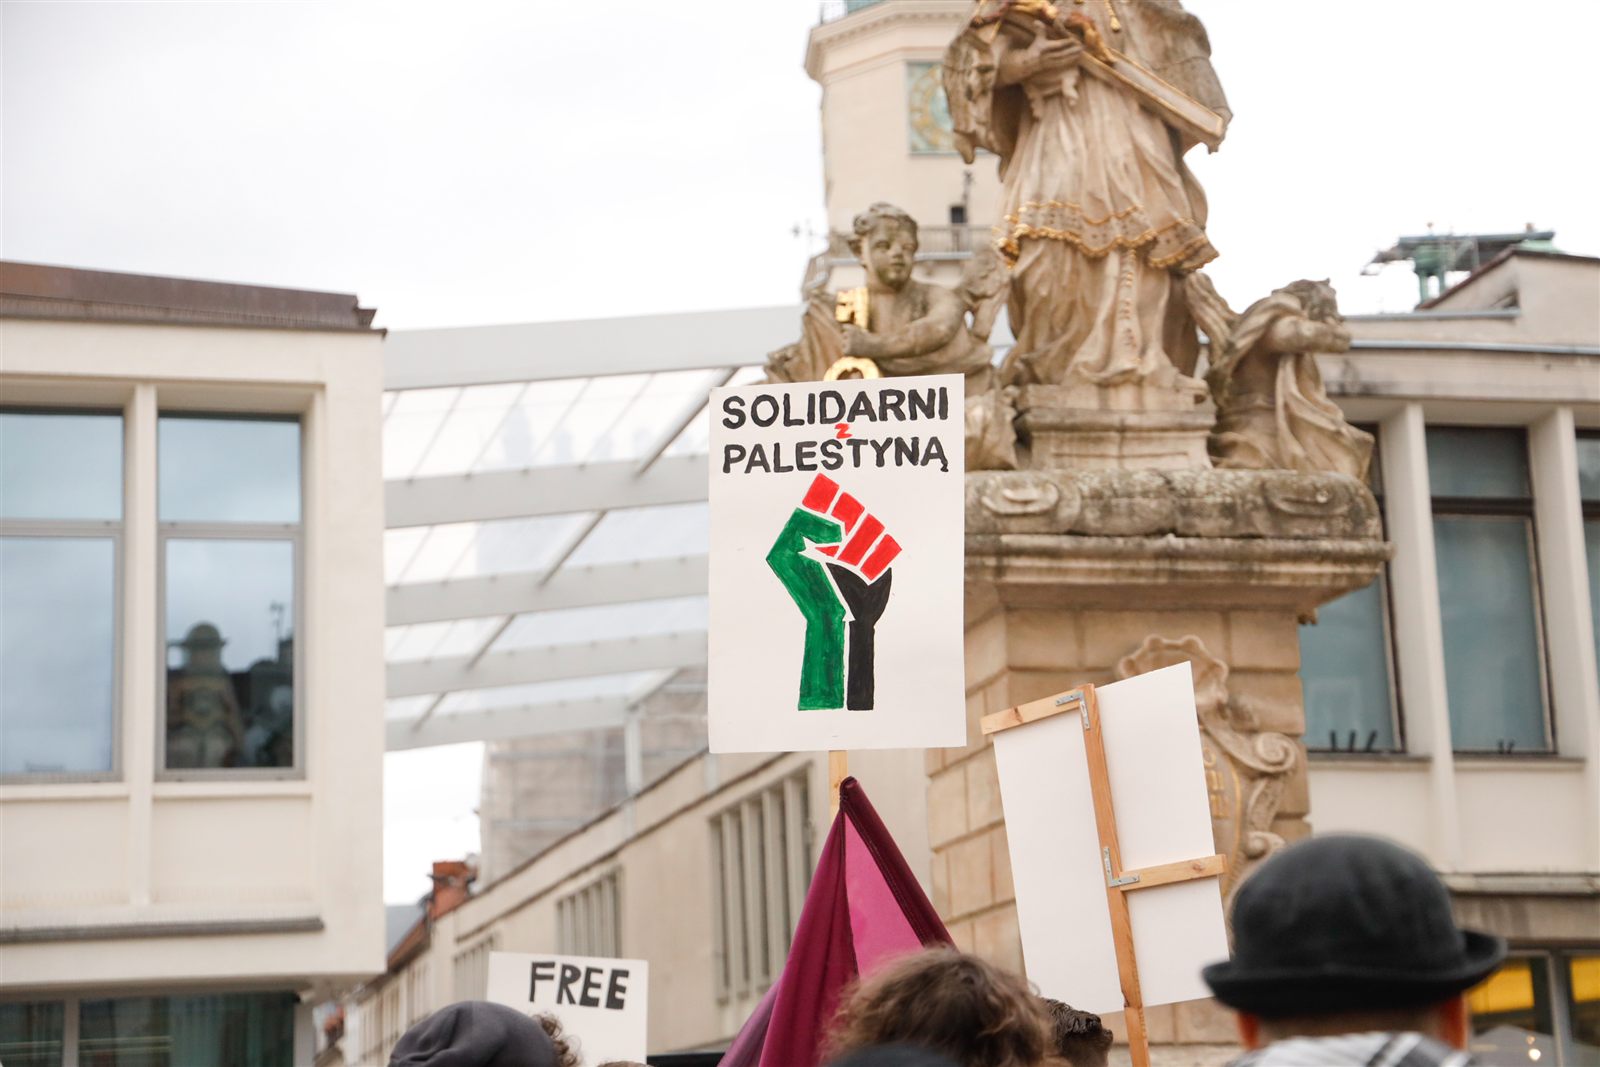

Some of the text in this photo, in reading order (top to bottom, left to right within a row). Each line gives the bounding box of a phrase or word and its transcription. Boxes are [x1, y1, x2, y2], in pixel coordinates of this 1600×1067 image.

[722, 387, 949, 430] SOLIDARNI
[722, 436, 949, 473] PALESTYNĄ
[529, 961, 629, 1010] FREE
